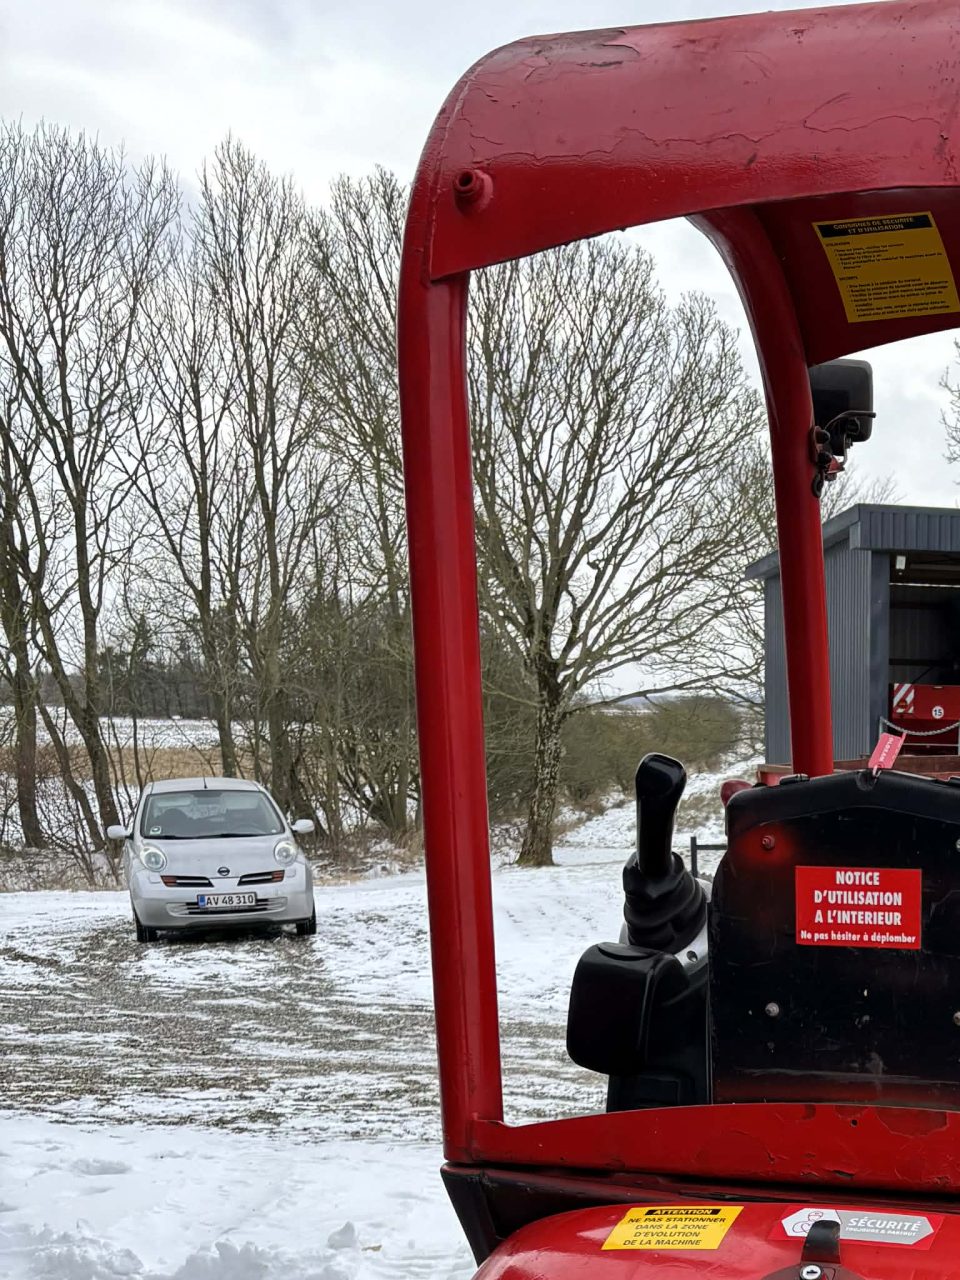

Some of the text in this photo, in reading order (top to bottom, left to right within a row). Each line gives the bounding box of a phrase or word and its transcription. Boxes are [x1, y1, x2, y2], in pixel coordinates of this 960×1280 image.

[835, 870, 880, 886] NOTICE
[207, 895, 254, 905] AV 48 310
[814, 890, 902, 906] D'UTILISATION
[814, 909, 902, 926] A L'INTERIEUR
[800, 930, 916, 944] Ne pas hésiter à déplomber
[848, 1217, 922, 1231] SÉCURITÉ
